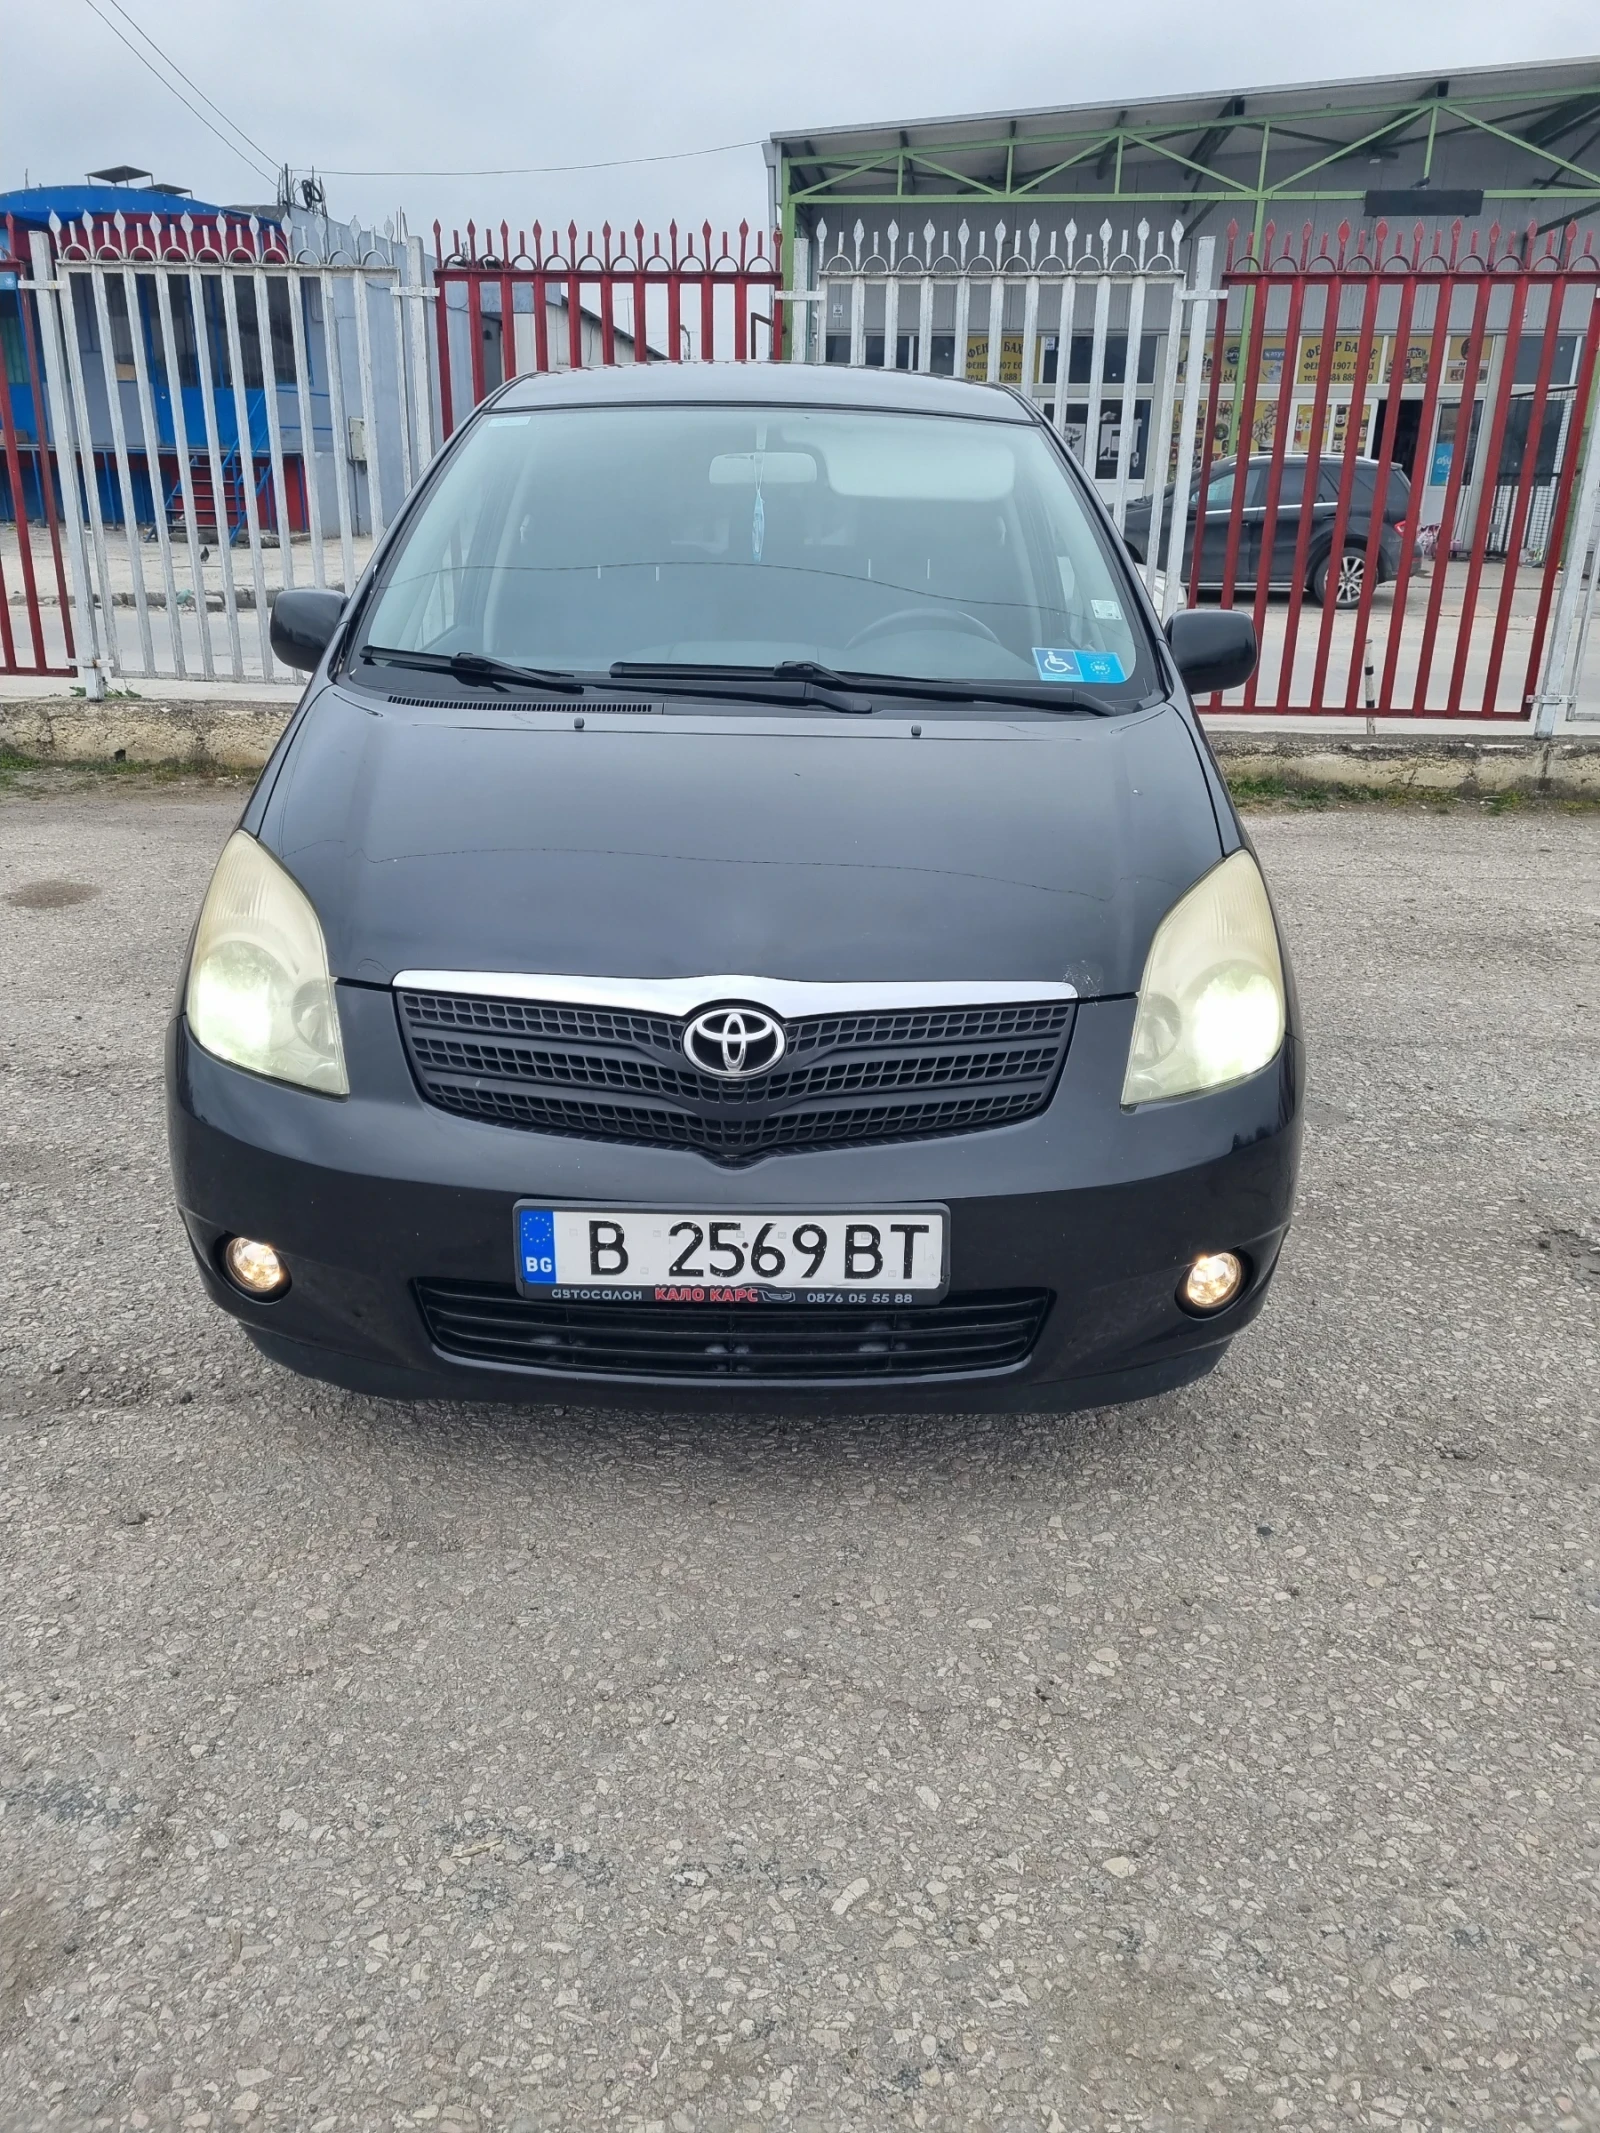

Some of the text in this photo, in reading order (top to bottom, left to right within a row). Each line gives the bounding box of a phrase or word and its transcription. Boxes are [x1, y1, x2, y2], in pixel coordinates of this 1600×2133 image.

[589, 1220, 929, 1280] B 2569 BT
[526, 1257, 552, 1273] BG
[655, 1287, 705, 1302] КАЛО
[709, 1288, 758, 1302] КАРС
[807, 1292, 843, 1304] 0876
[848, 1293, 866, 1304] 05
[871, 1293, 889, 1304] 55
[894, 1293, 912, 1304] 88
